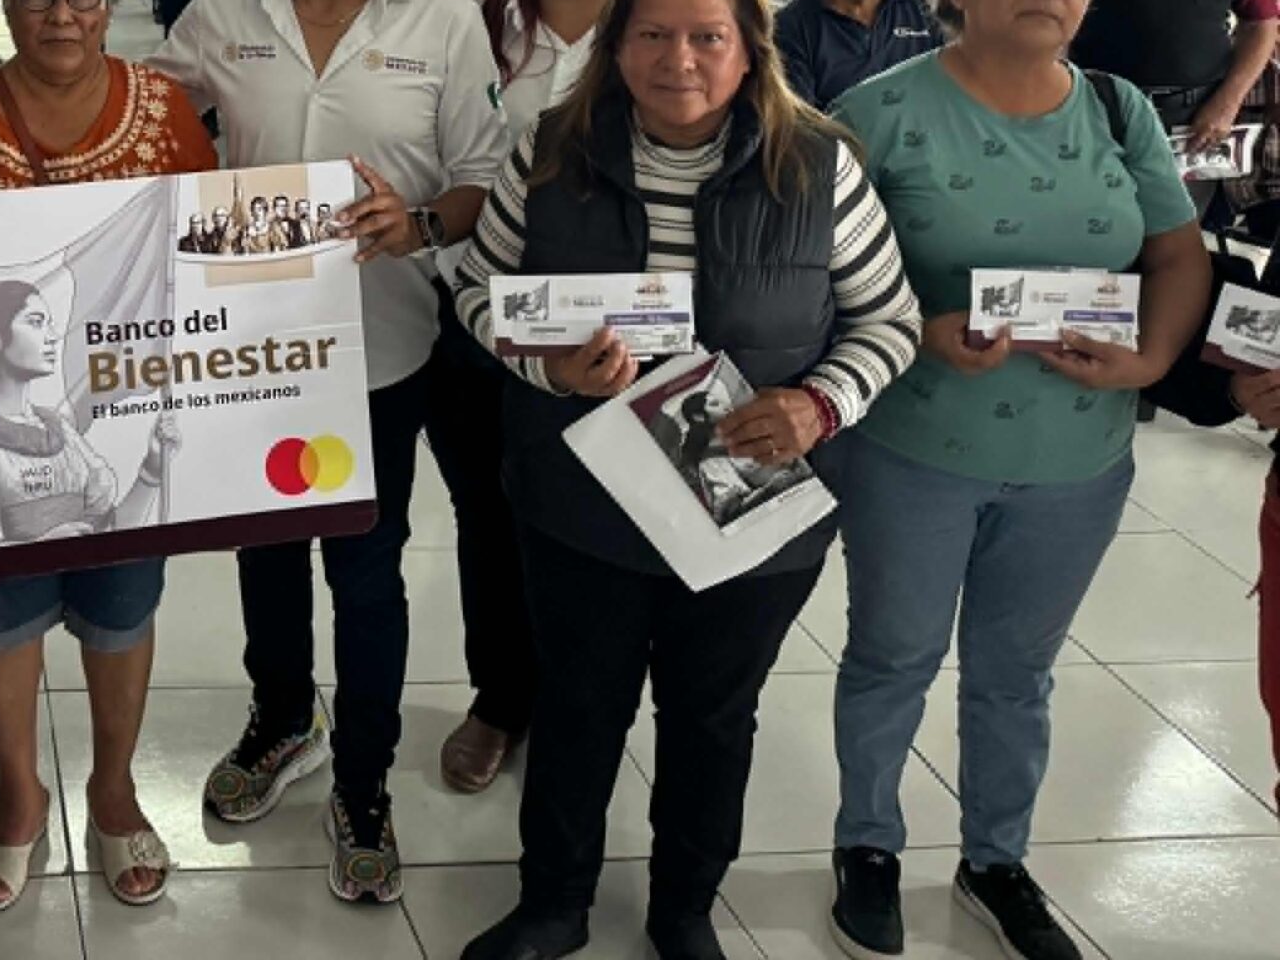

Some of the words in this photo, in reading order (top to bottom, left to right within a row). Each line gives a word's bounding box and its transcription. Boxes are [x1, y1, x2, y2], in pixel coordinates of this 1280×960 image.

[85, 318, 175, 345] Banco
[184, 307, 228, 334] del
[88, 336, 337, 394] Bienestar
[93, 404, 106, 419] El
[110, 400, 160, 418] banco
[162, 394, 184, 411] de
[188, 393, 211, 408] los
[215, 385, 301, 406] mexicanos
